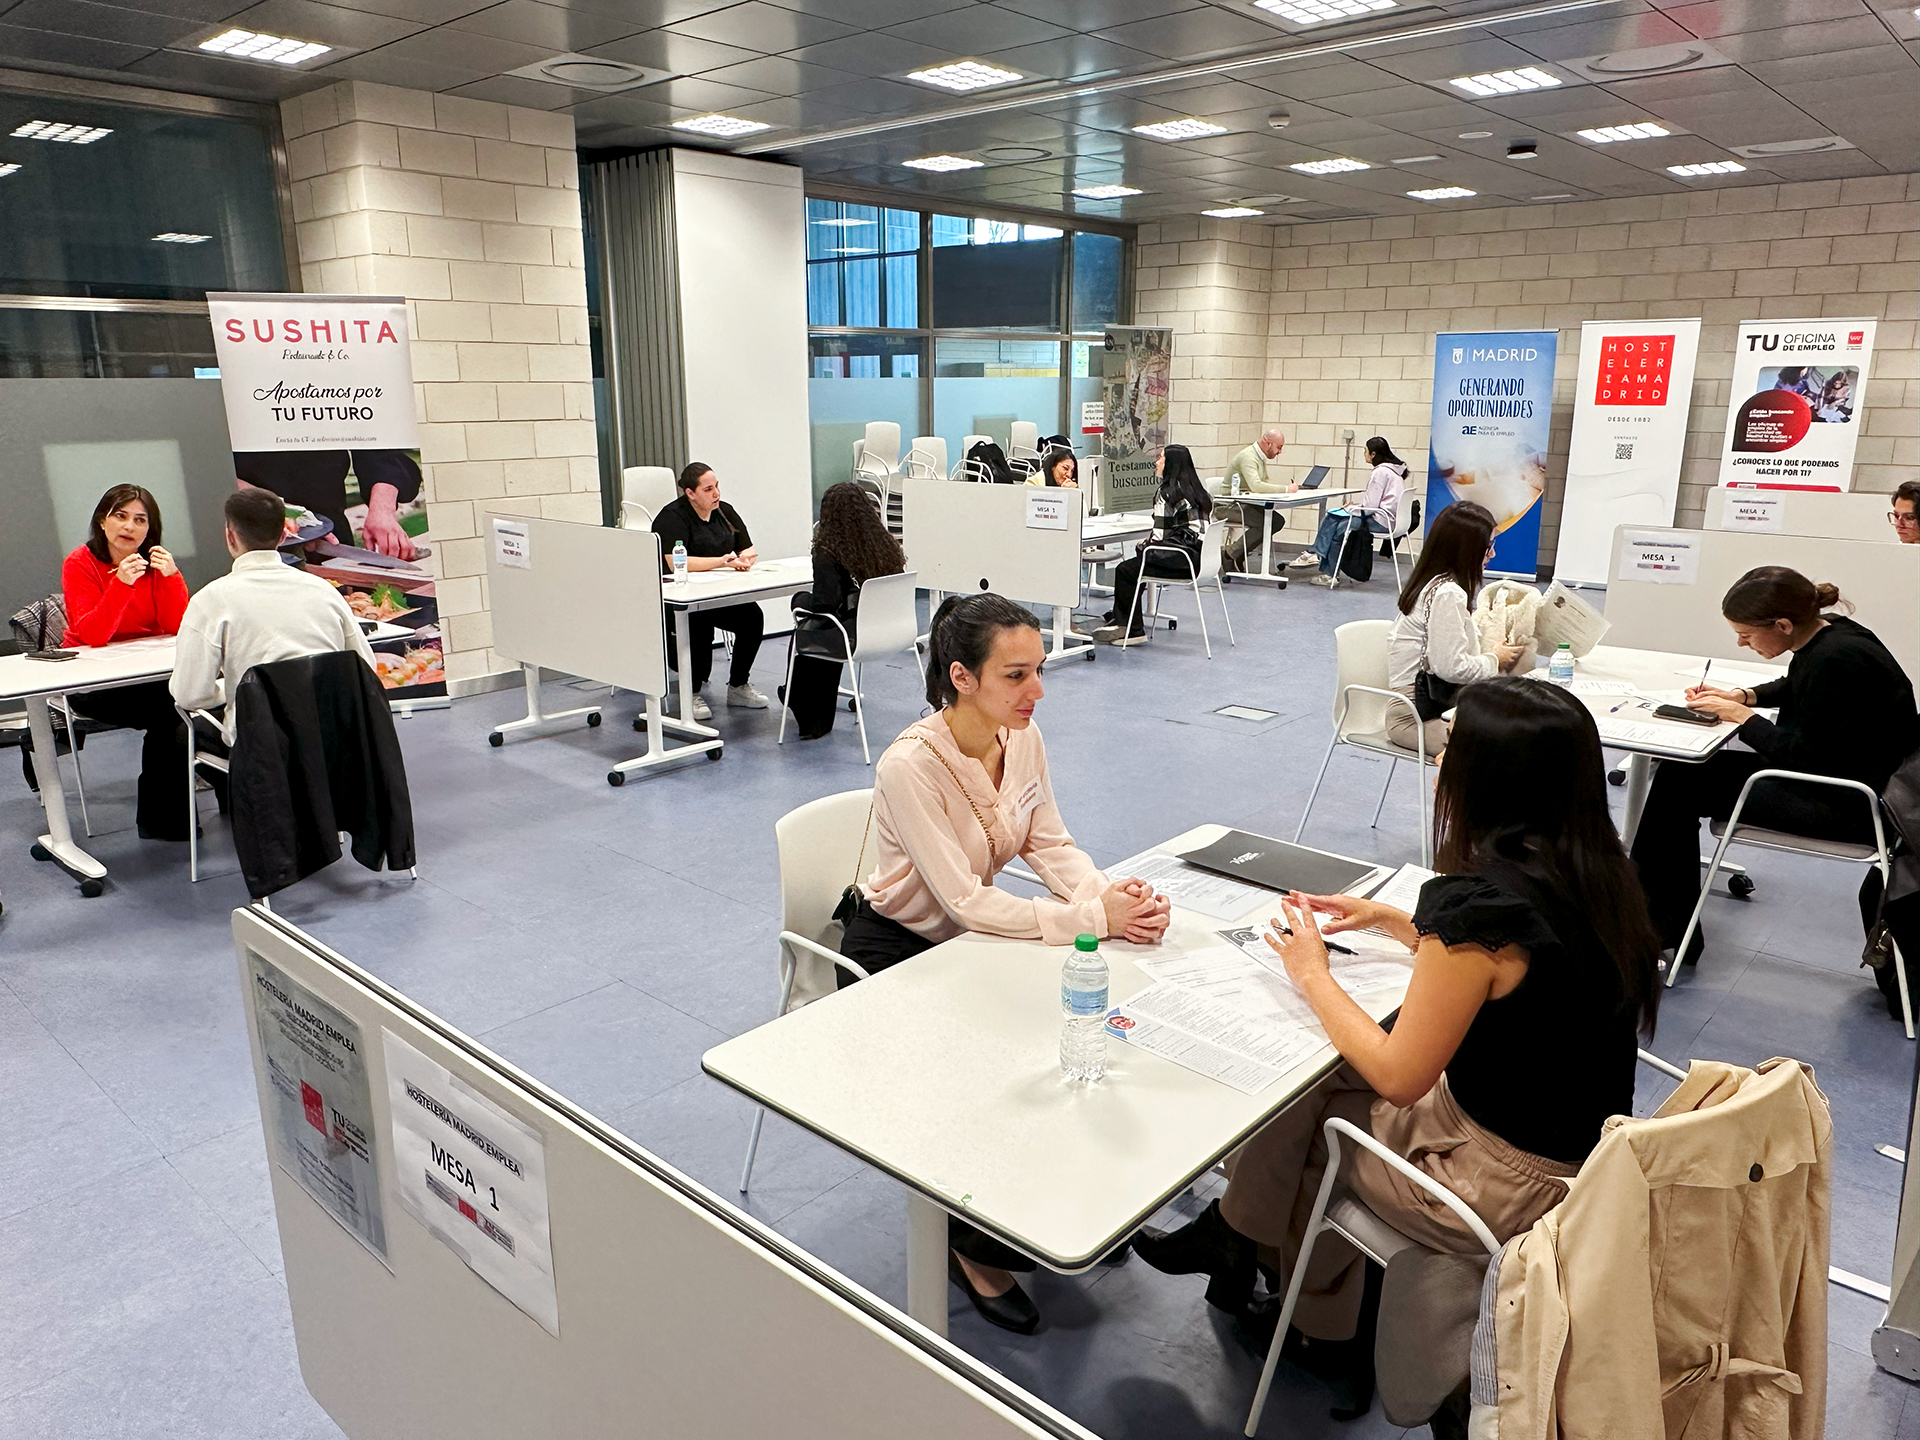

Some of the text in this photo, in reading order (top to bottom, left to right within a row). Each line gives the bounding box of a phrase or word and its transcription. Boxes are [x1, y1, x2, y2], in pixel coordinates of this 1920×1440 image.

[225, 318, 398, 344] SUSHITA
[1746, 333, 1836, 352] TU OFICINA
[1782, 344, 1835, 352] DE EMPLEO
[1472, 348, 1538, 362] MADRID
[253, 380, 383, 404] Apostamos por
[1459, 378, 1525, 396] GENERANDO
[271, 407, 373, 421] TU FUTURO
[1448, 399, 1534, 418] OPORTUNIDADES
[1108, 461, 1157, 473] Te estamos
[1642, 553, 1665, 561] MESA
[256, 973, 293, 1011] HOSTELERÍA
[294, 1003, 324, 1032] MADRID
[325, 1024, 357, 1054] EMPLEA
[331, 1107, 345, 1129] TU
[406, 1085, 521, 1176] HOSTELERÍA MADRID EMPLEA
[430, 1140, 476, 1194] MESA
[489, 1186, 499, 1211] 1
